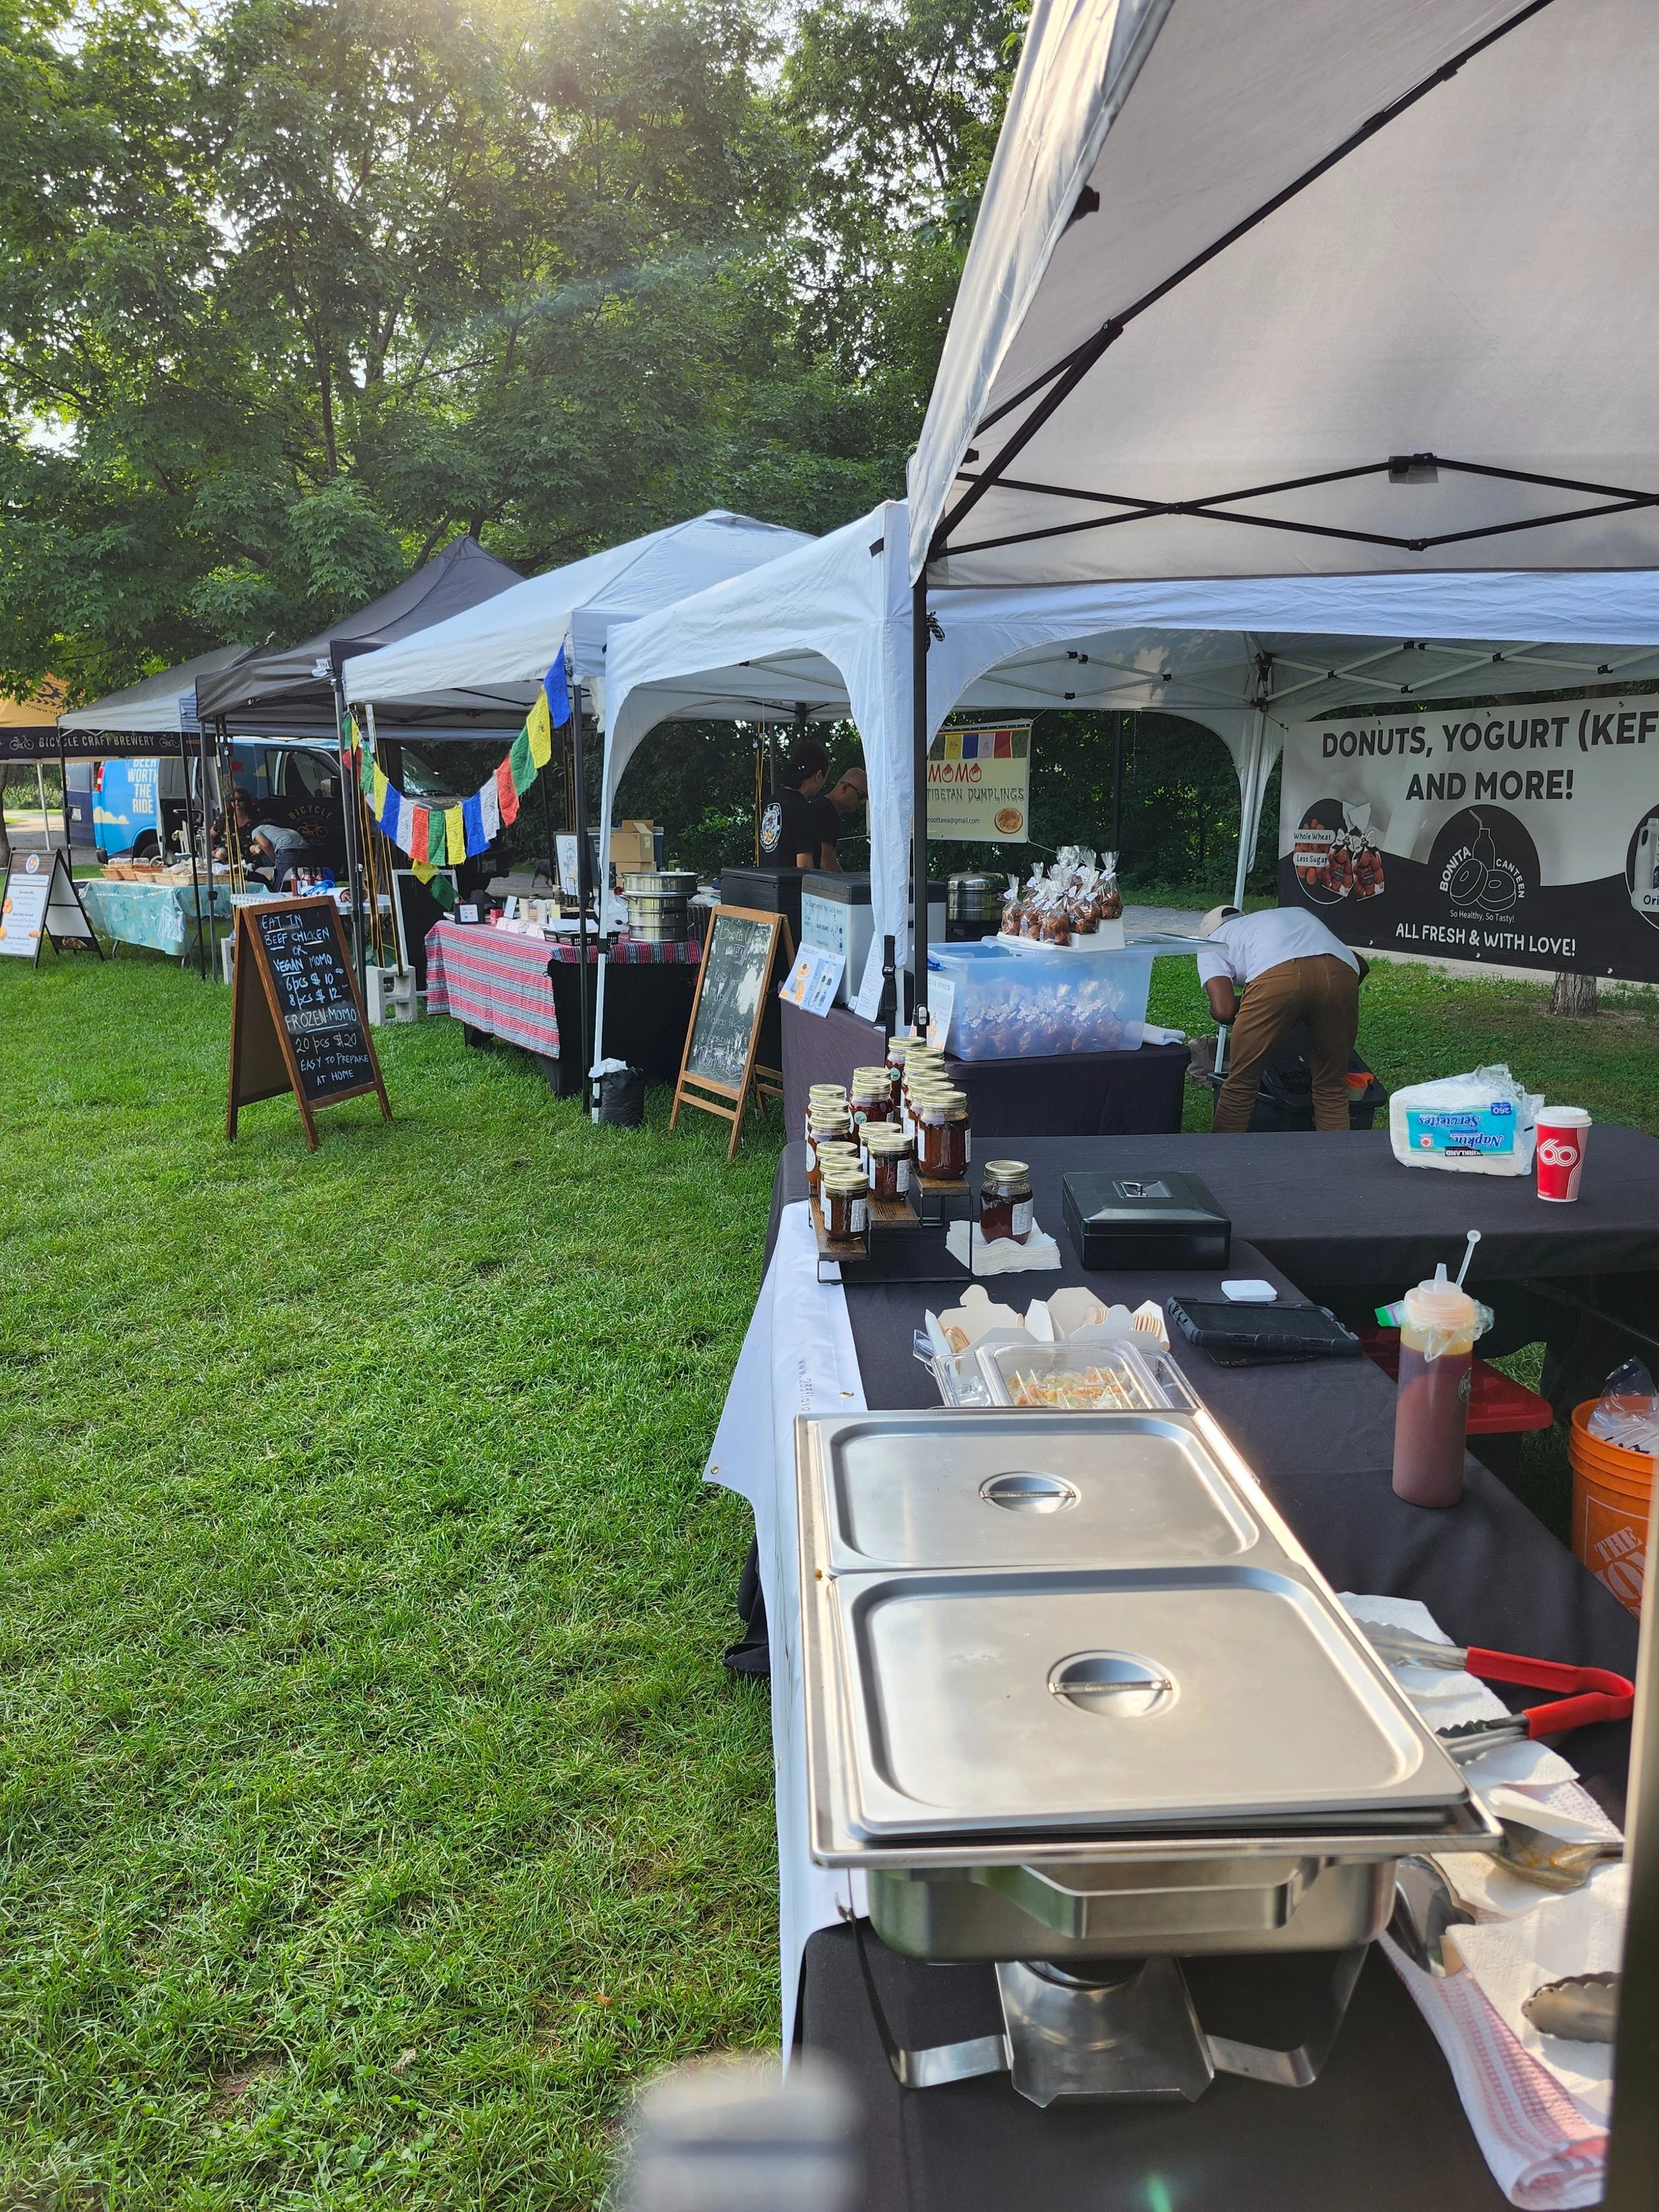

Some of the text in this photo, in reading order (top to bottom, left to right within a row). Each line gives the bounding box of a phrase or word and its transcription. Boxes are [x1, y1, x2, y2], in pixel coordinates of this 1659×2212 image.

[114, 735, 155, 747] BREWERY
[1323, 709, 1659, 758] DONUTS, YOGURT (KEF
[928, 763, 982, 783] MOMO
[134, 784, 152, 798] THE
[1406, 770, 1574, 800] AND MORE!
[927, 787, 1025, 803] TIBETAN DUMPLINGS
[133, 798, 154, 814] RIDE
[288, 805, 333, 820] BICYCLE
[1309, 855, 1327, 865] Sugar
[1439, 846, 1471, 892] BONITA
[1496, 859, 1525, 898] CANTEEN
[261, 914, 303, 929] EAT IN
[1459, 911, 1484, 921] Healthy,
[1485, 913, 1494, 921] So
[1495, 914, 1514, 924] Tasty!
[264, 926, 330, 946] BEEF CHICKEN
[1396, 922, 1576, 957] ALL FRESH & WITH LOVE!
[293, 944, 308, 956] OR
[273, 953, 332, 972] VEGAN MOMO
[286, 976, 309, 994] 6pcs
[295, 1032, 357, 1055] 20 pcs $20
[301, 1057, 321, 1072] EASY
[336, 1053, 369, 1065] PREPARE
[317, 1069, 354, 1086] AT HOME
[1419, 1116, 1480, 1128] Serviettes
[1594, 1526, 1643, 1562] THE
